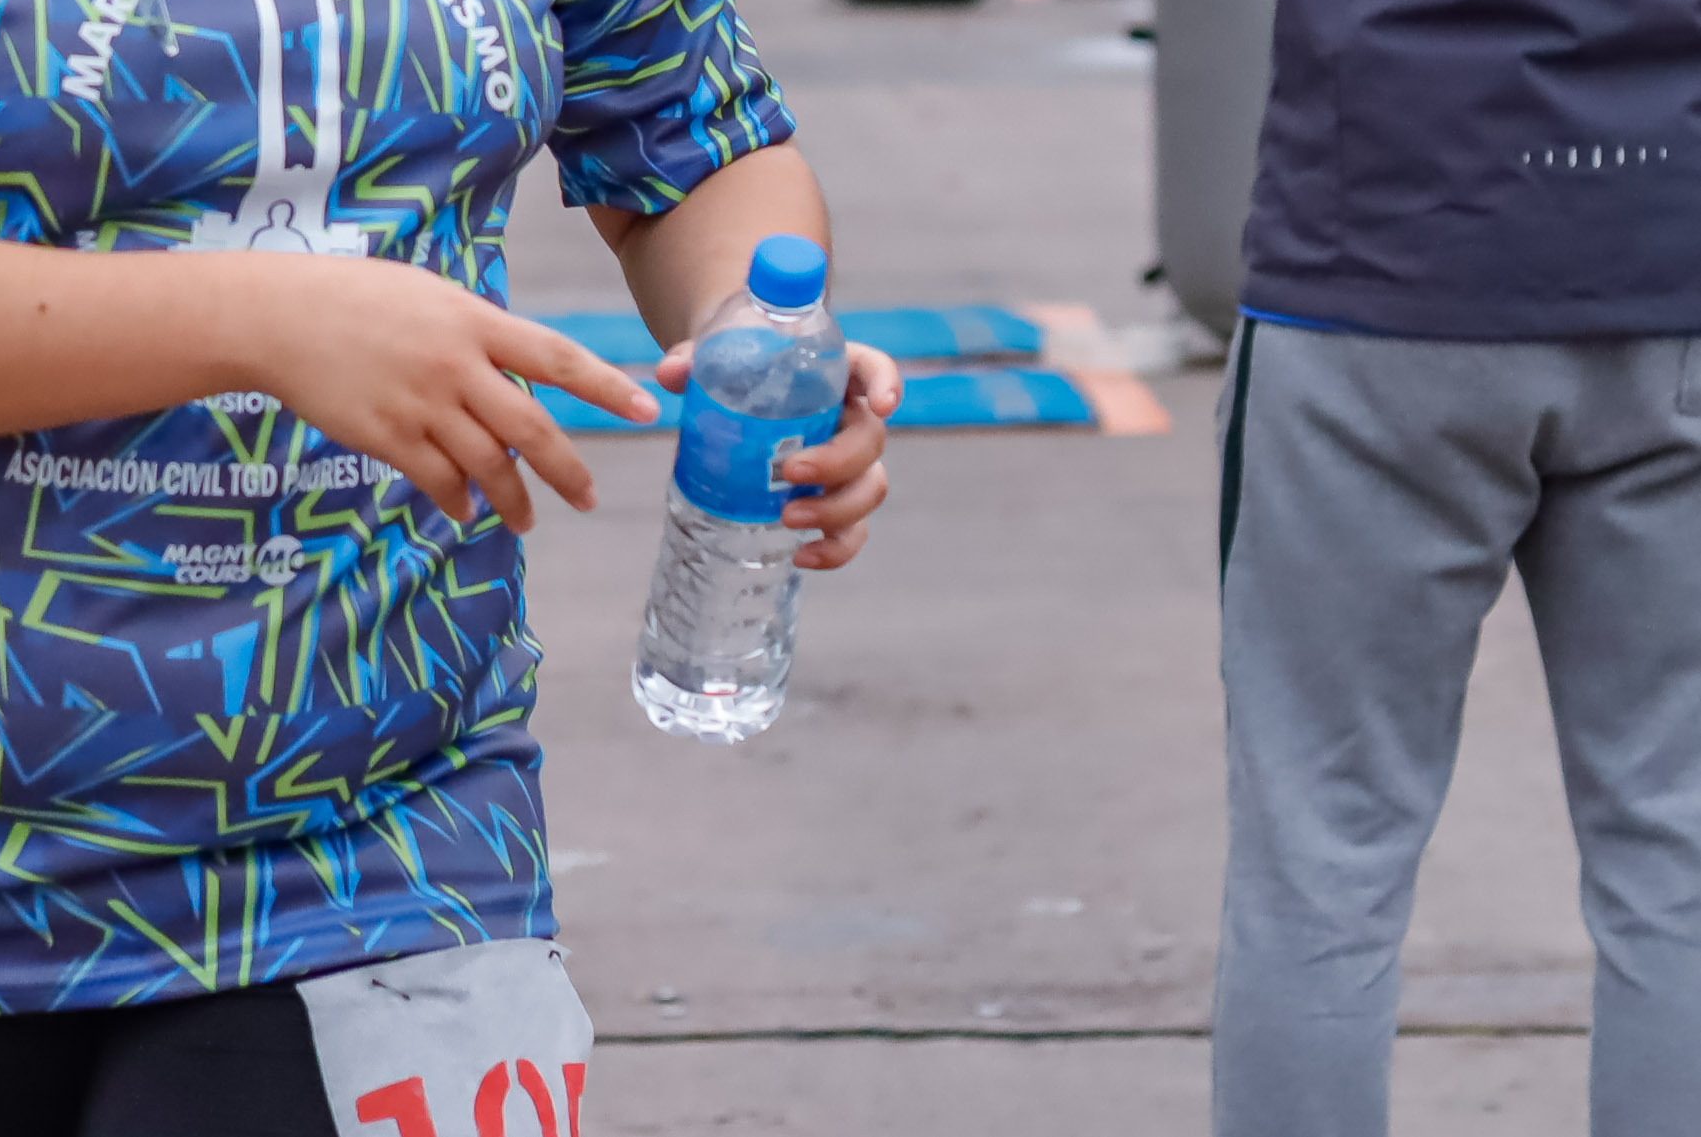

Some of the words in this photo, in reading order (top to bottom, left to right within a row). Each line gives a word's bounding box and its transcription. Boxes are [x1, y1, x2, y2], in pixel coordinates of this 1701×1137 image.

[3, 447, 157, 496] ASOCIACIÓN
[161, 461, 225, 497] CIVIL
[228, 461, 279, 499] TGD
